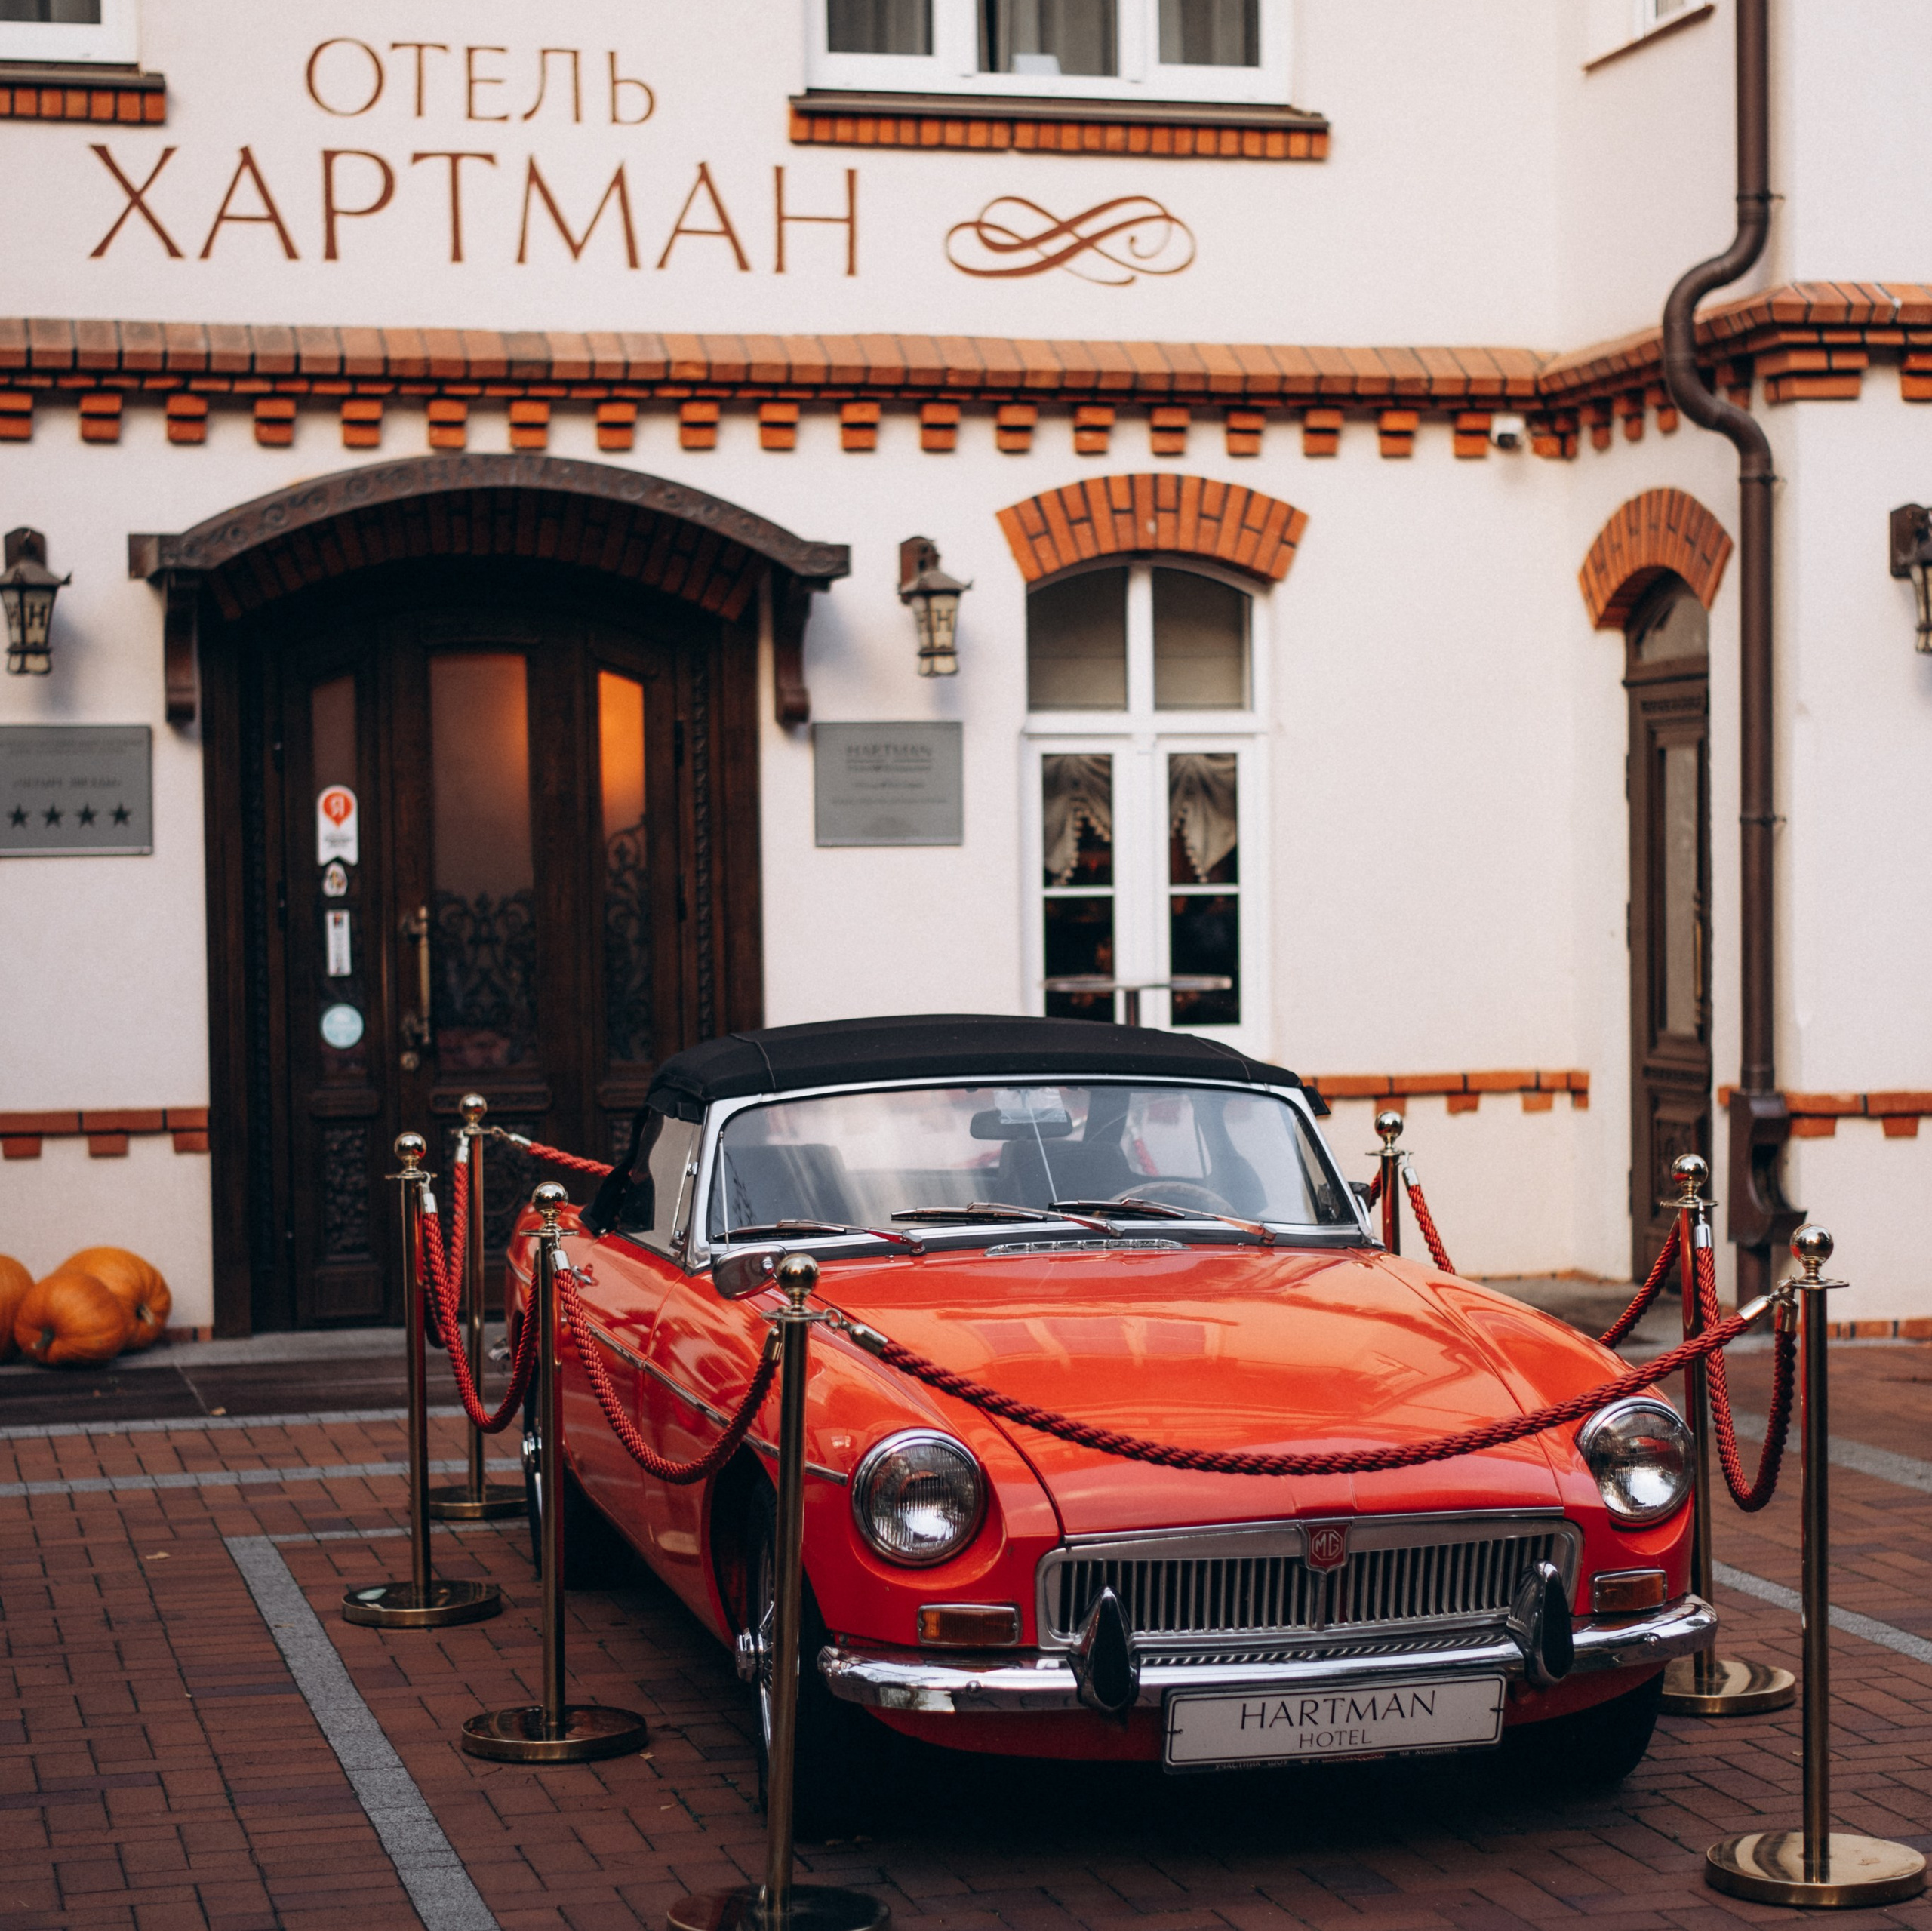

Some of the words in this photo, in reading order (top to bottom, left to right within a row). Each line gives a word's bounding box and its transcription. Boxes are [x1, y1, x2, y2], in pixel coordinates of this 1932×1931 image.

[305, 38, 656, 125] ОТЕЛЬ
[88, 143, 857, 277] ХАРТМАН
[1315, 1533, 1339, 1557] MG
[1240, 1690, 1436, 1730] HARTMAN
[1299, 1729, 1373, 1748] HOTEL
